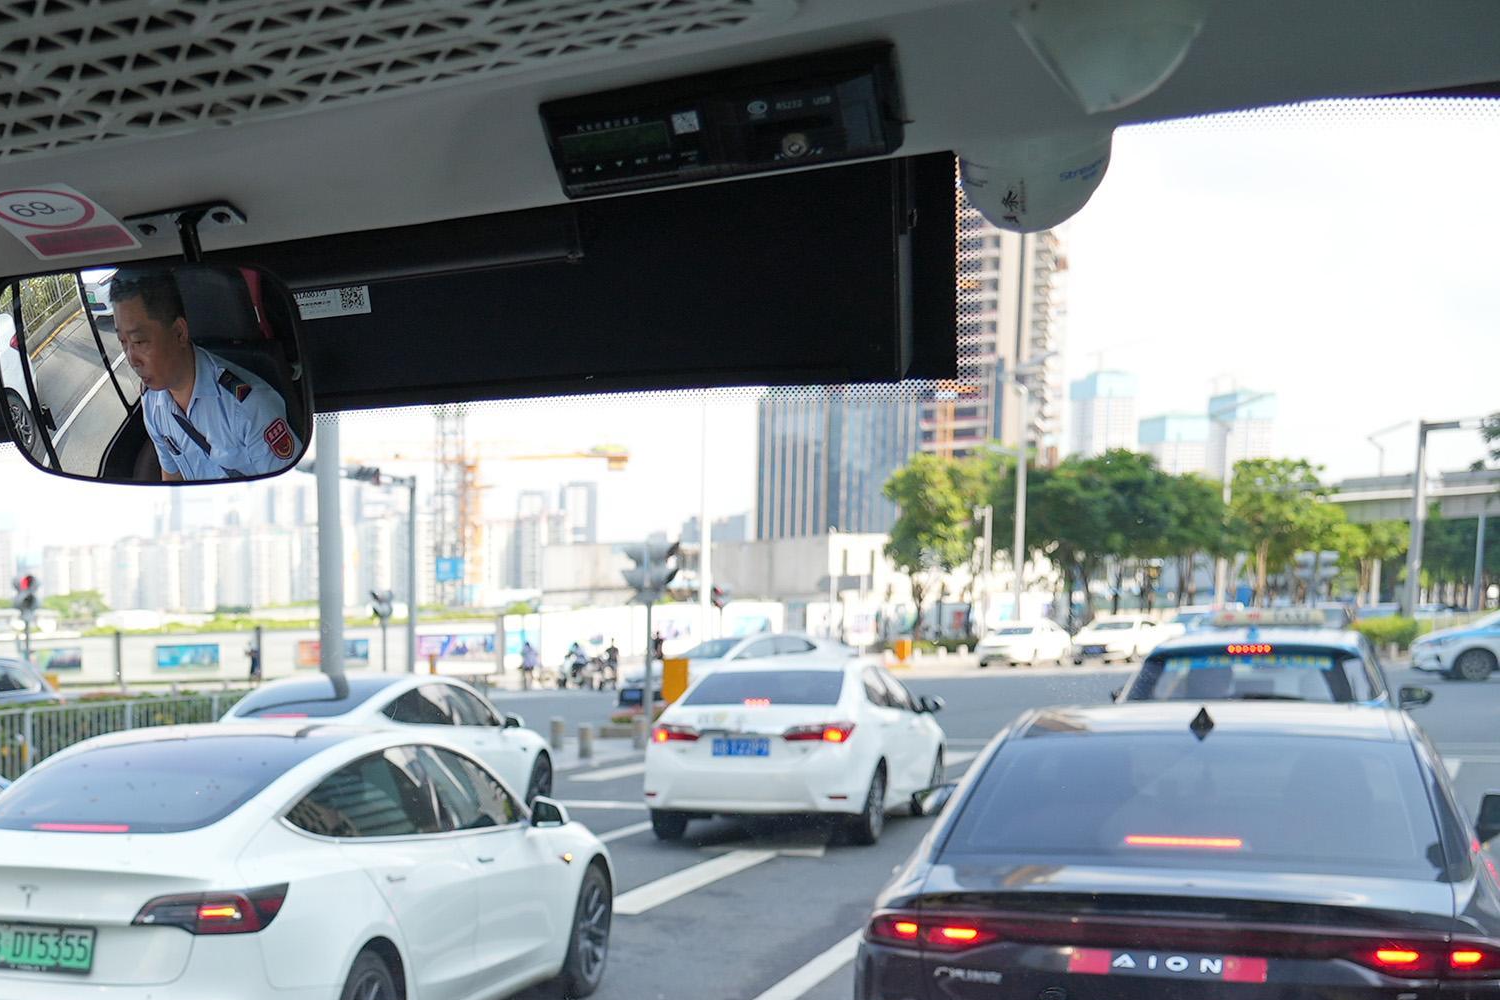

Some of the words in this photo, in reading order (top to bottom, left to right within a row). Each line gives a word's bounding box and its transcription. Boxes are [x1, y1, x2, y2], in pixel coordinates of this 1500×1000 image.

[9, 201, 56, 218] 69
[12, 931, 89, 962] DT5355
[1111, 953, 1224, 975] AION
